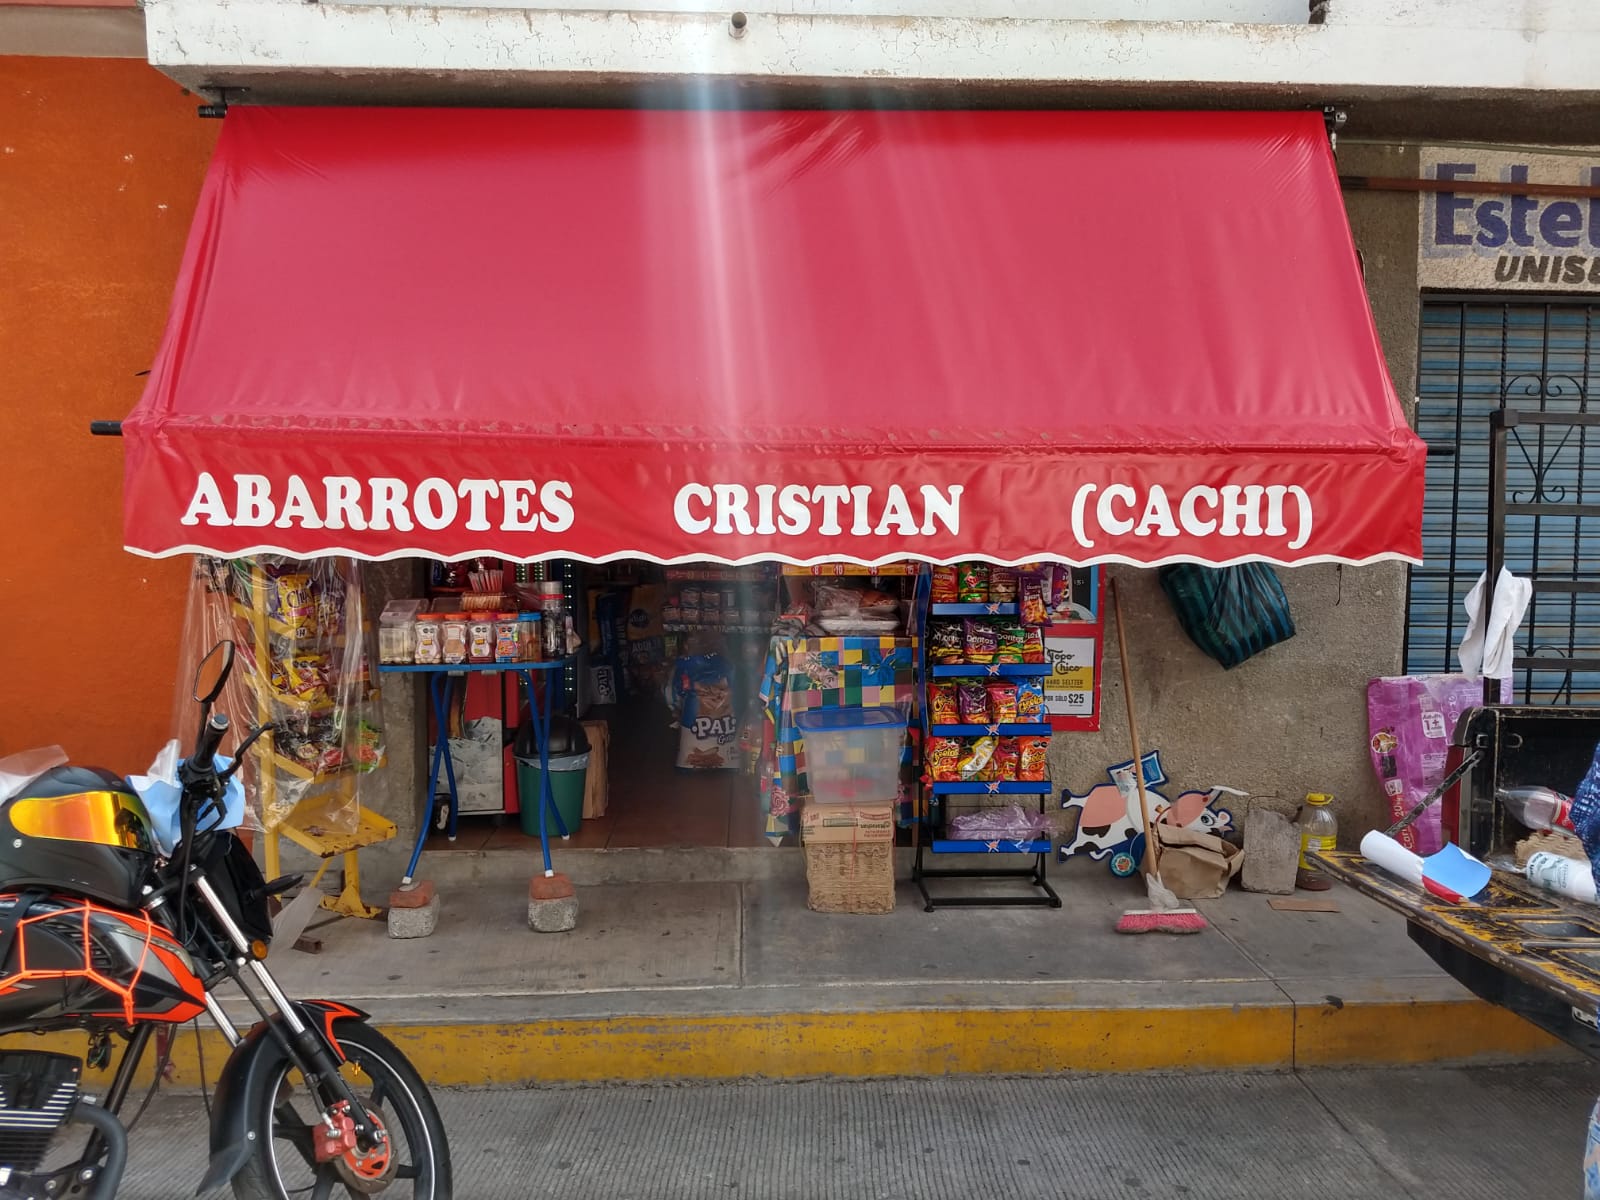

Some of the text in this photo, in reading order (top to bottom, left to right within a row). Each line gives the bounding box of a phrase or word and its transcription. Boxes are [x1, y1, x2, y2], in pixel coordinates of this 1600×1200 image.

[180, 471, 1313, 550] ABARROTES CRISTIAN (CACHI)
[966, 634, 994, 645] Doritos
[1046, 648, 1075, 663] Topo
[1055, 661, 1083, 675] Chico
[1068, 693, 1085, 704] $25
[1393, 805, 1404, 817] 20
